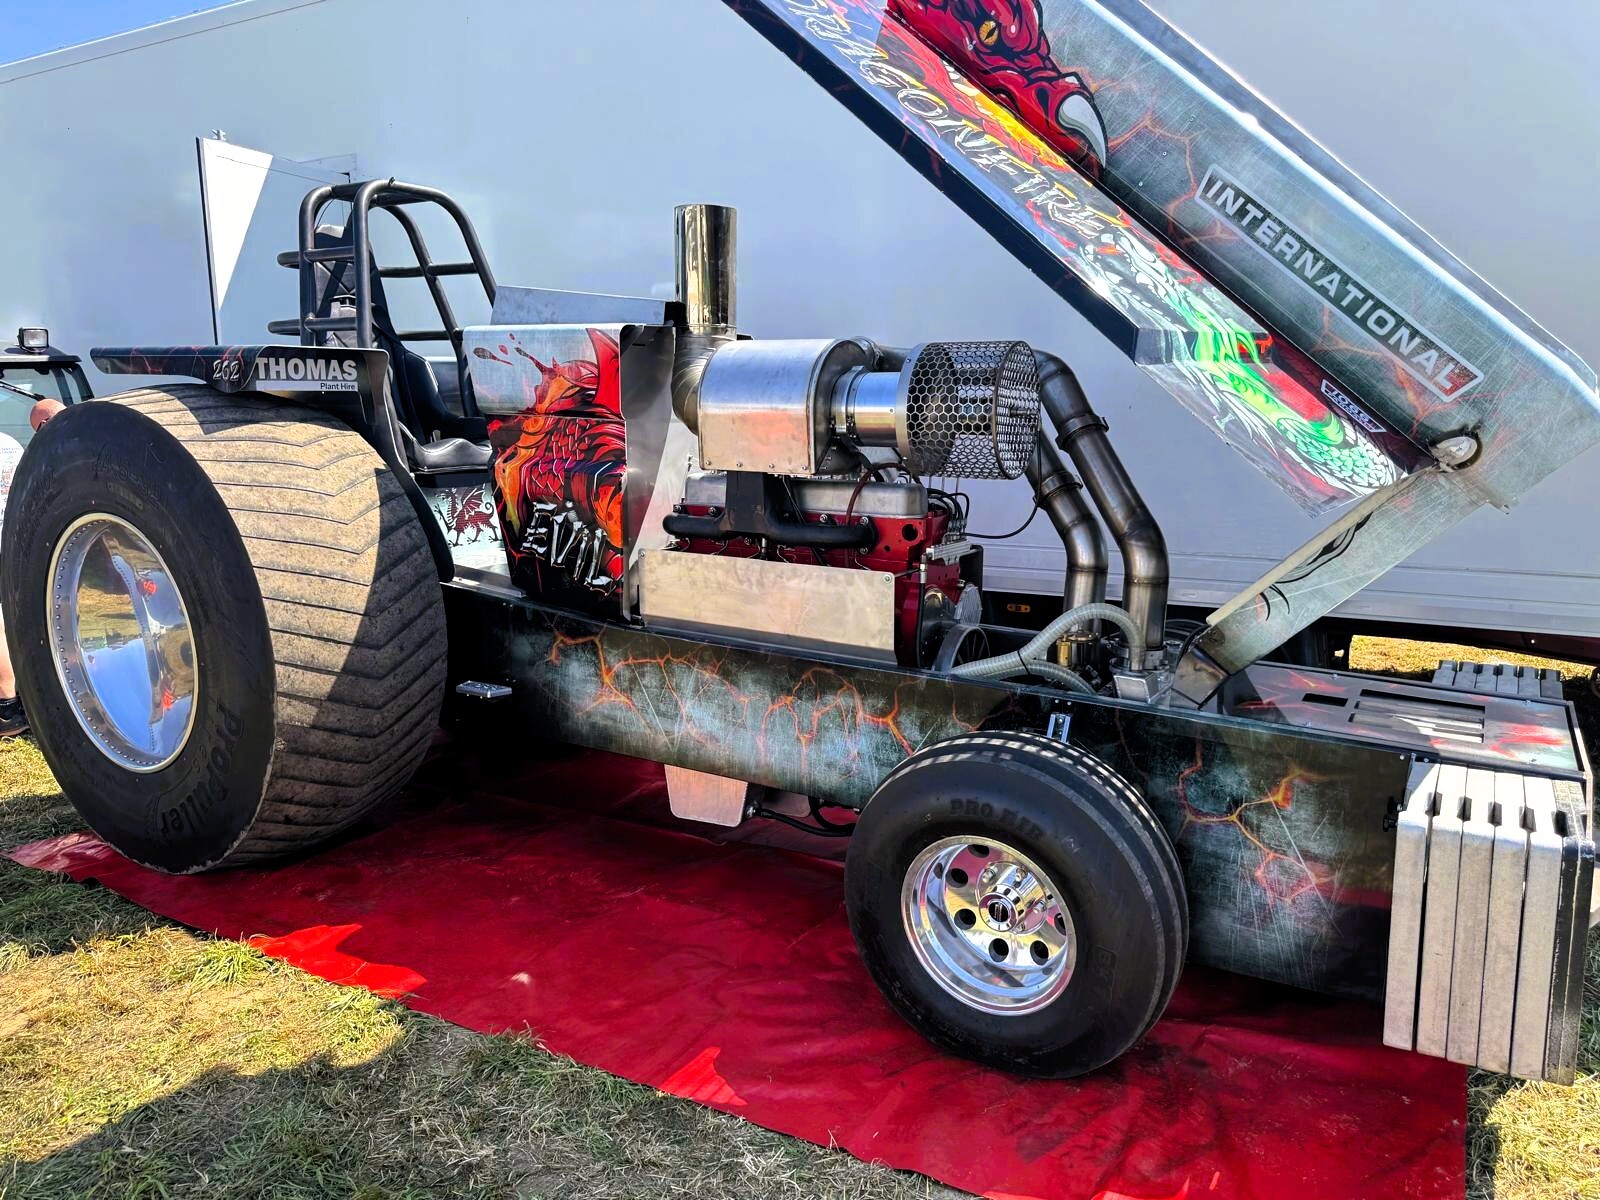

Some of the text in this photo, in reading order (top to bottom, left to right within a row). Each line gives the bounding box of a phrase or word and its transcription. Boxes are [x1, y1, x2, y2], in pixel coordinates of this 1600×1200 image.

[1206, 181, 1456, 391] INTERNATIONAL
[256, 357, 358, 381] THOMAS
[320, 382, 356, 391] Plant Hire
